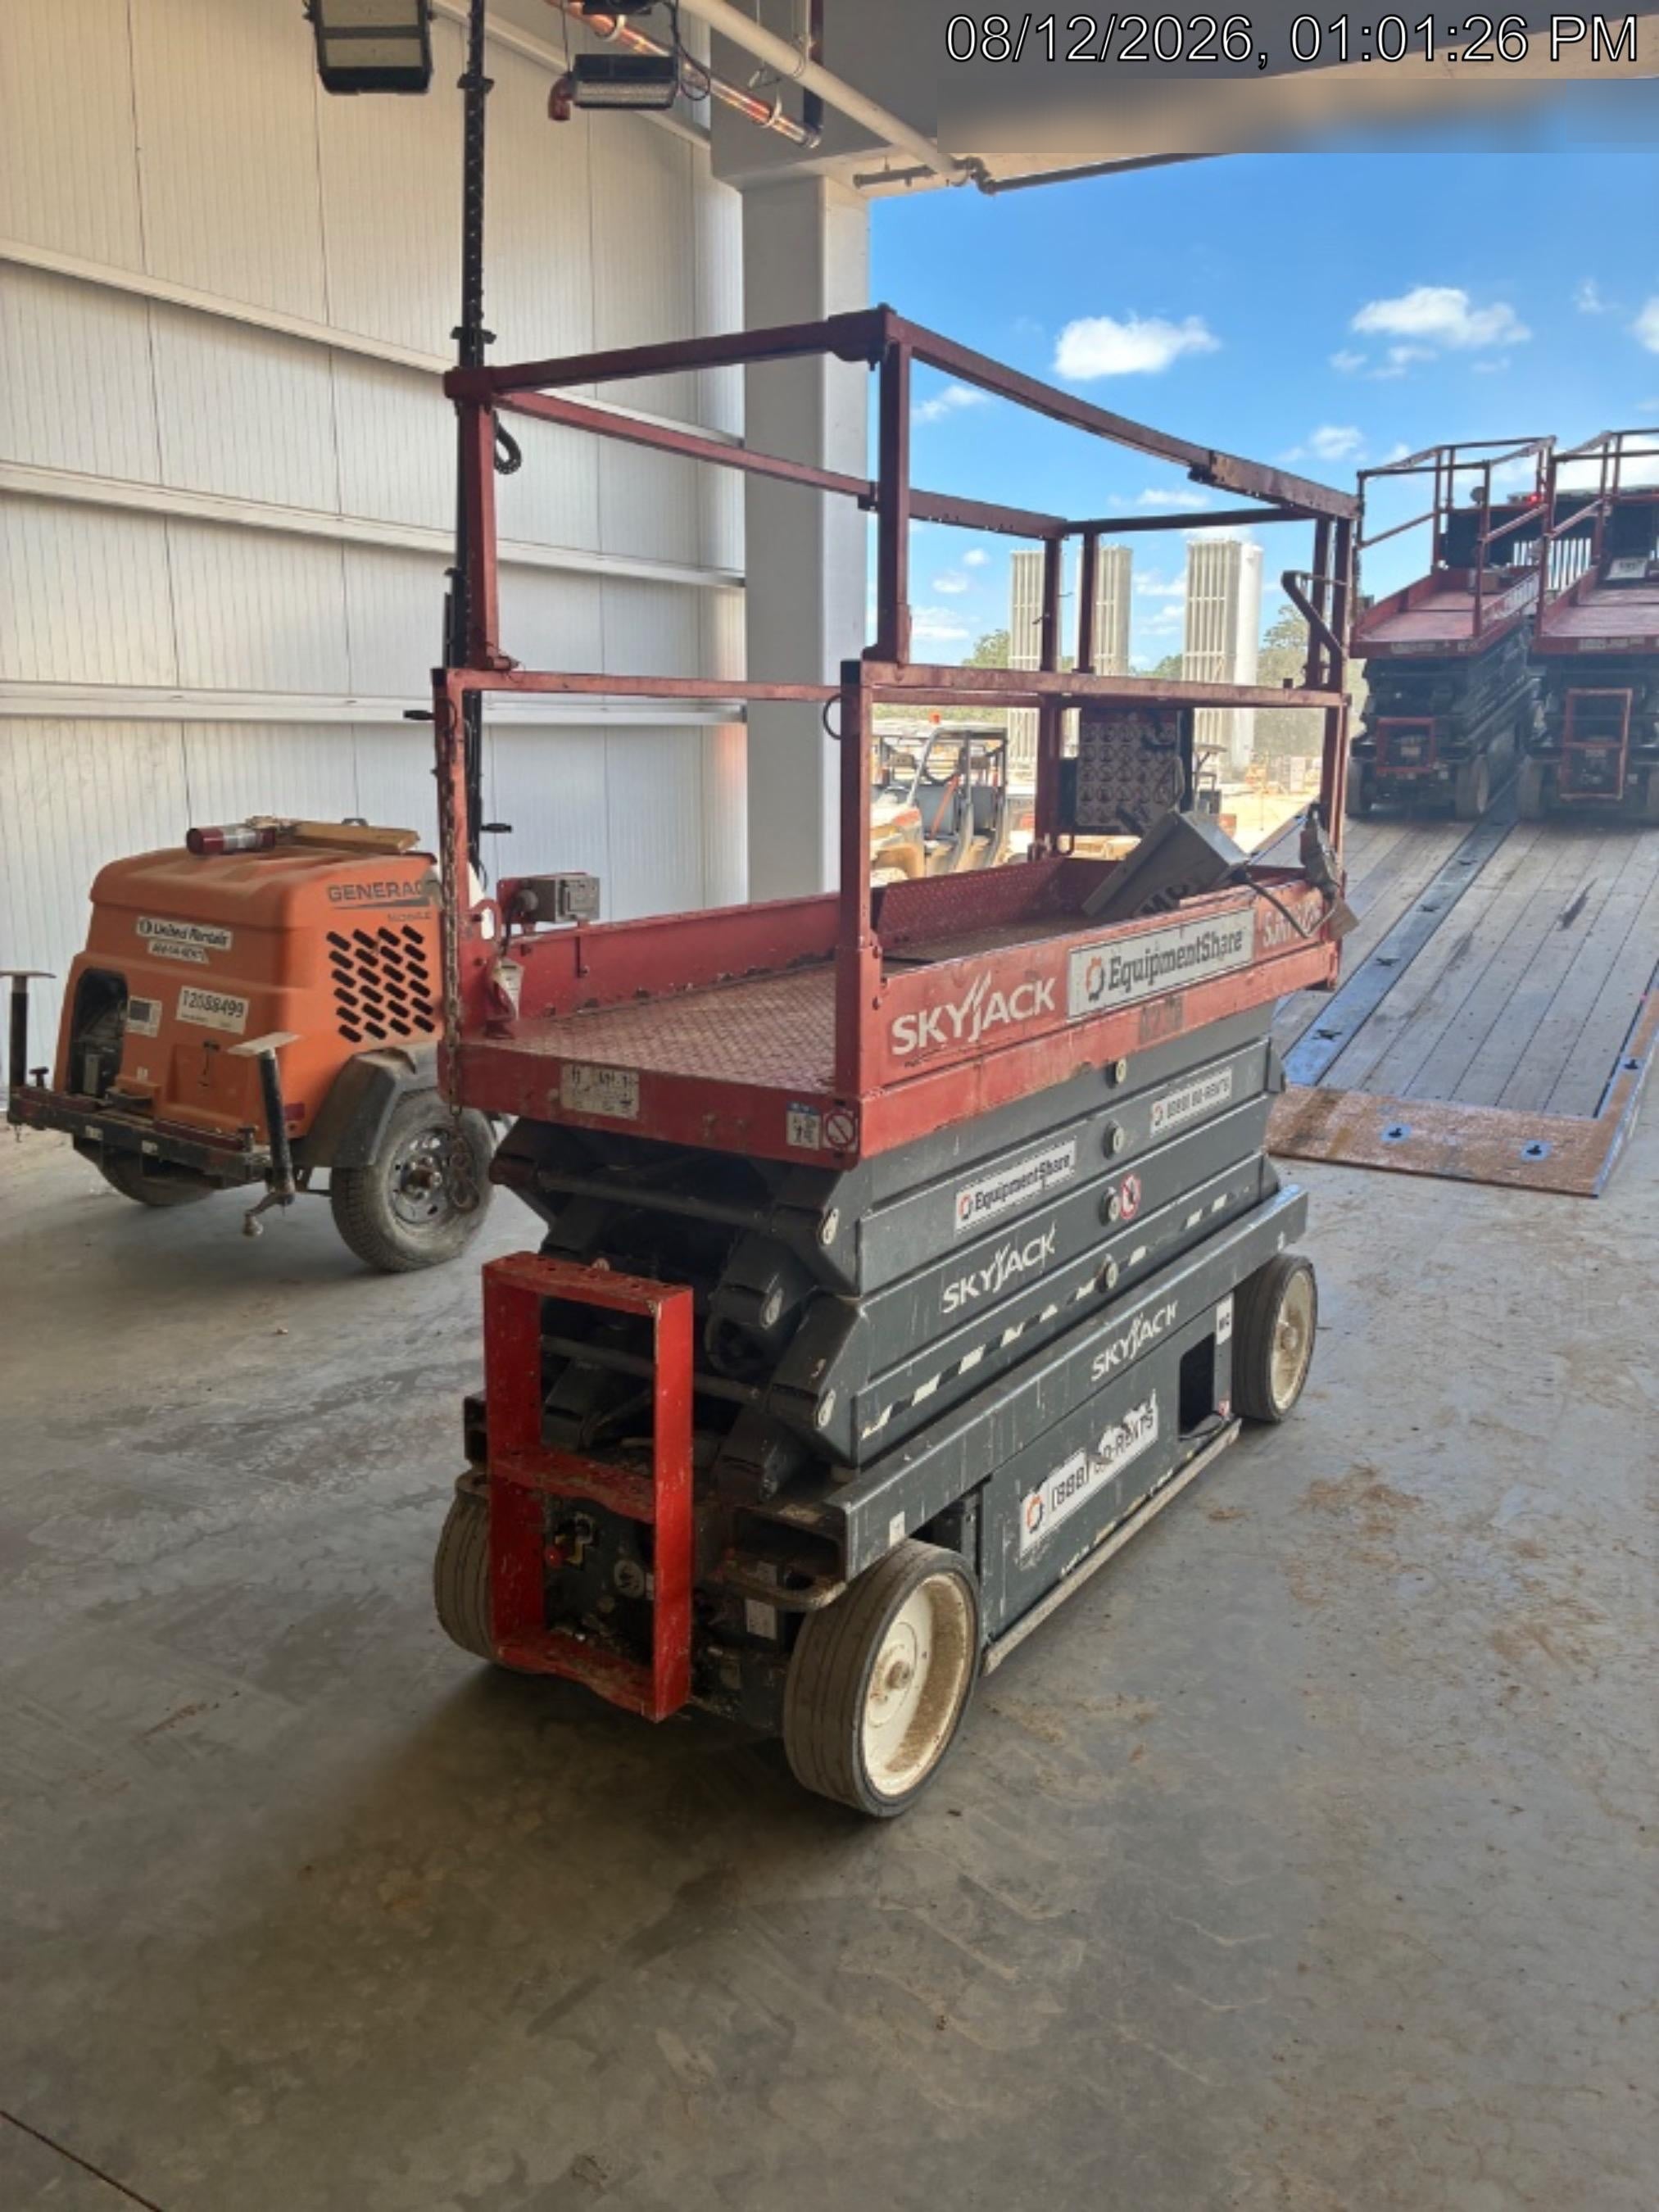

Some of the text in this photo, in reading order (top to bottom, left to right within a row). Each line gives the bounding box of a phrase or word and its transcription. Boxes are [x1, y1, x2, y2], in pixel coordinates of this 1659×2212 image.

[1108, 930, 1242, 992] EquipmentShare
[891, 970, 1056, 1055] SKYJACK
[976, 1154, 1070, 1209] EquipmentShare
[943, 1222, 1055, 1312] SKYJACK
[1091, 1300, 1178, 1382] SKYJACK
